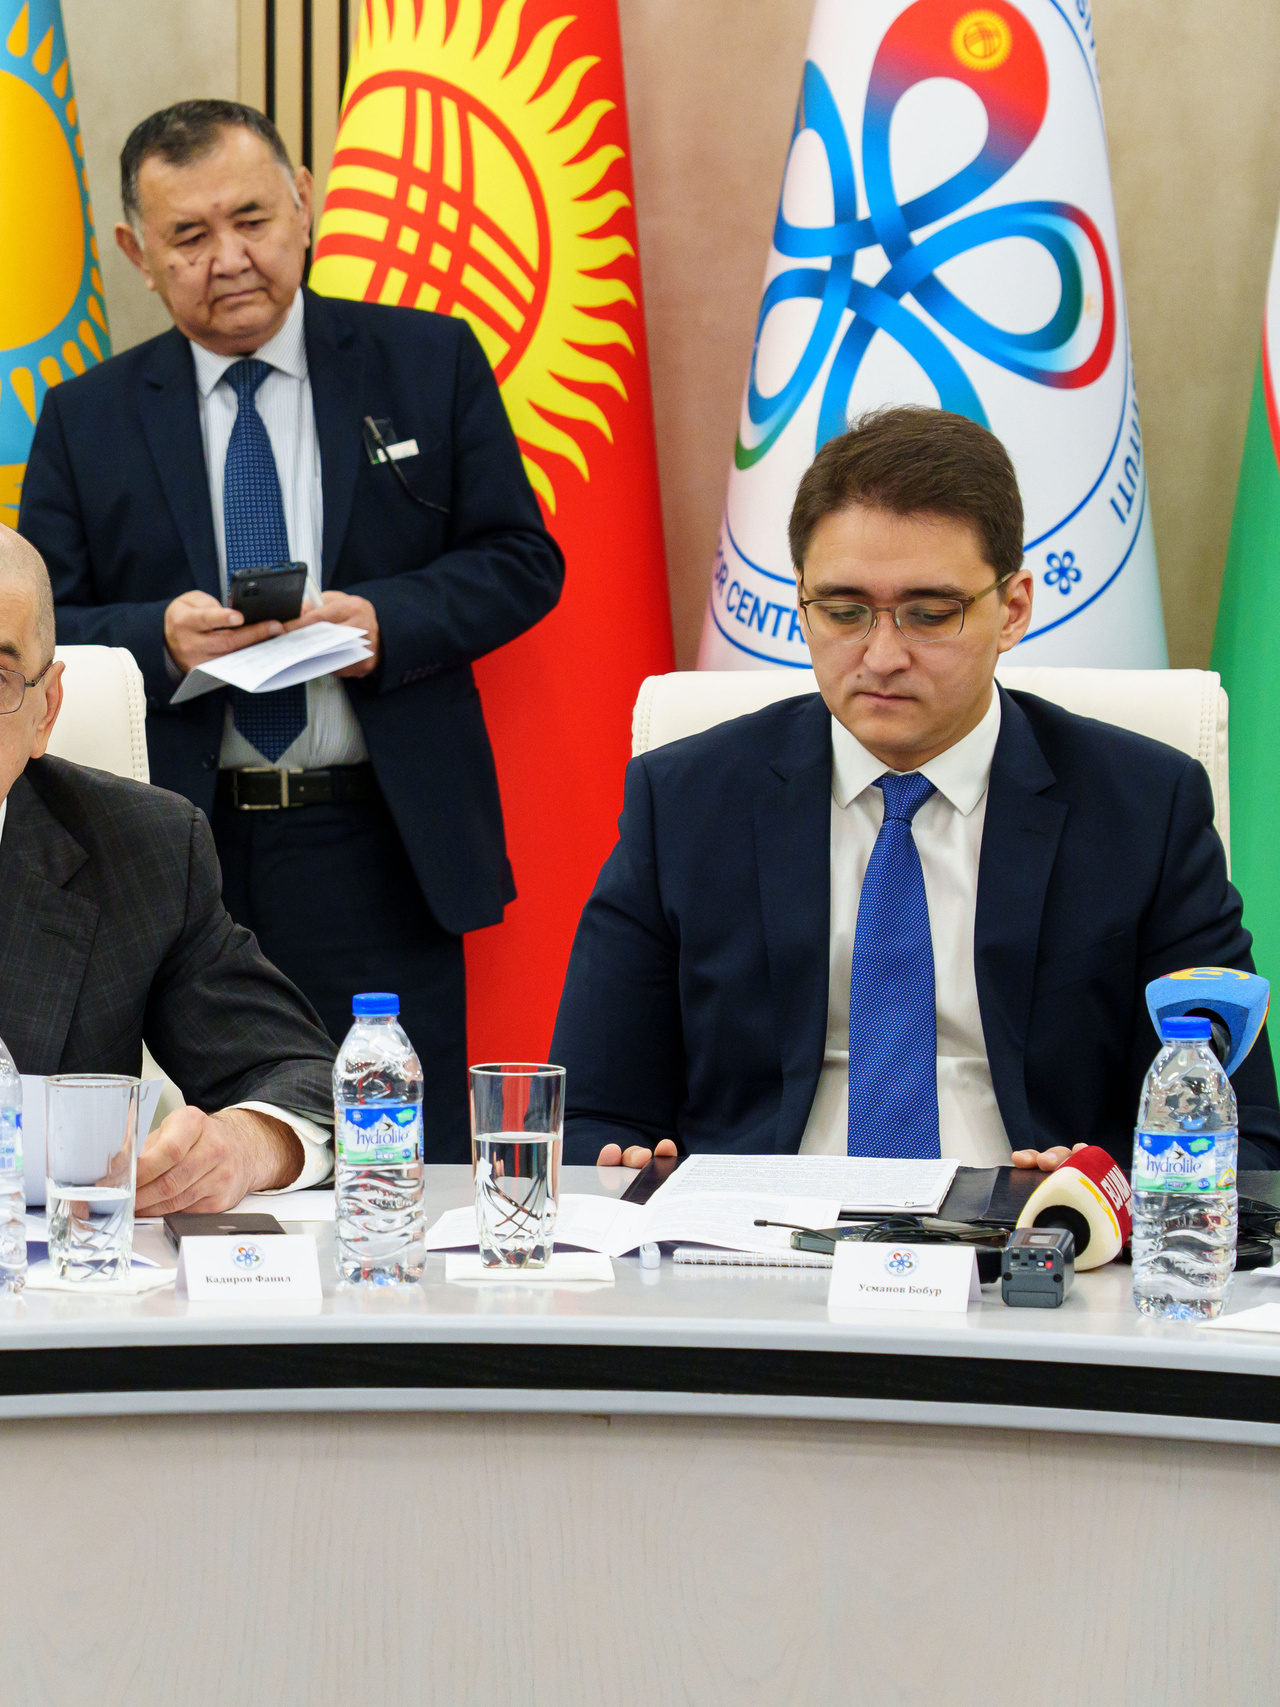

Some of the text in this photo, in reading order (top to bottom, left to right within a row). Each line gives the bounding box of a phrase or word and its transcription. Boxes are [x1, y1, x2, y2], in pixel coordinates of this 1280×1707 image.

[726, 580, 806, 644] CENTR
[205, 1275, 292, 1285] Кадиров Фанил
[858, 1283, 942, 1297] Усманов Бобур
